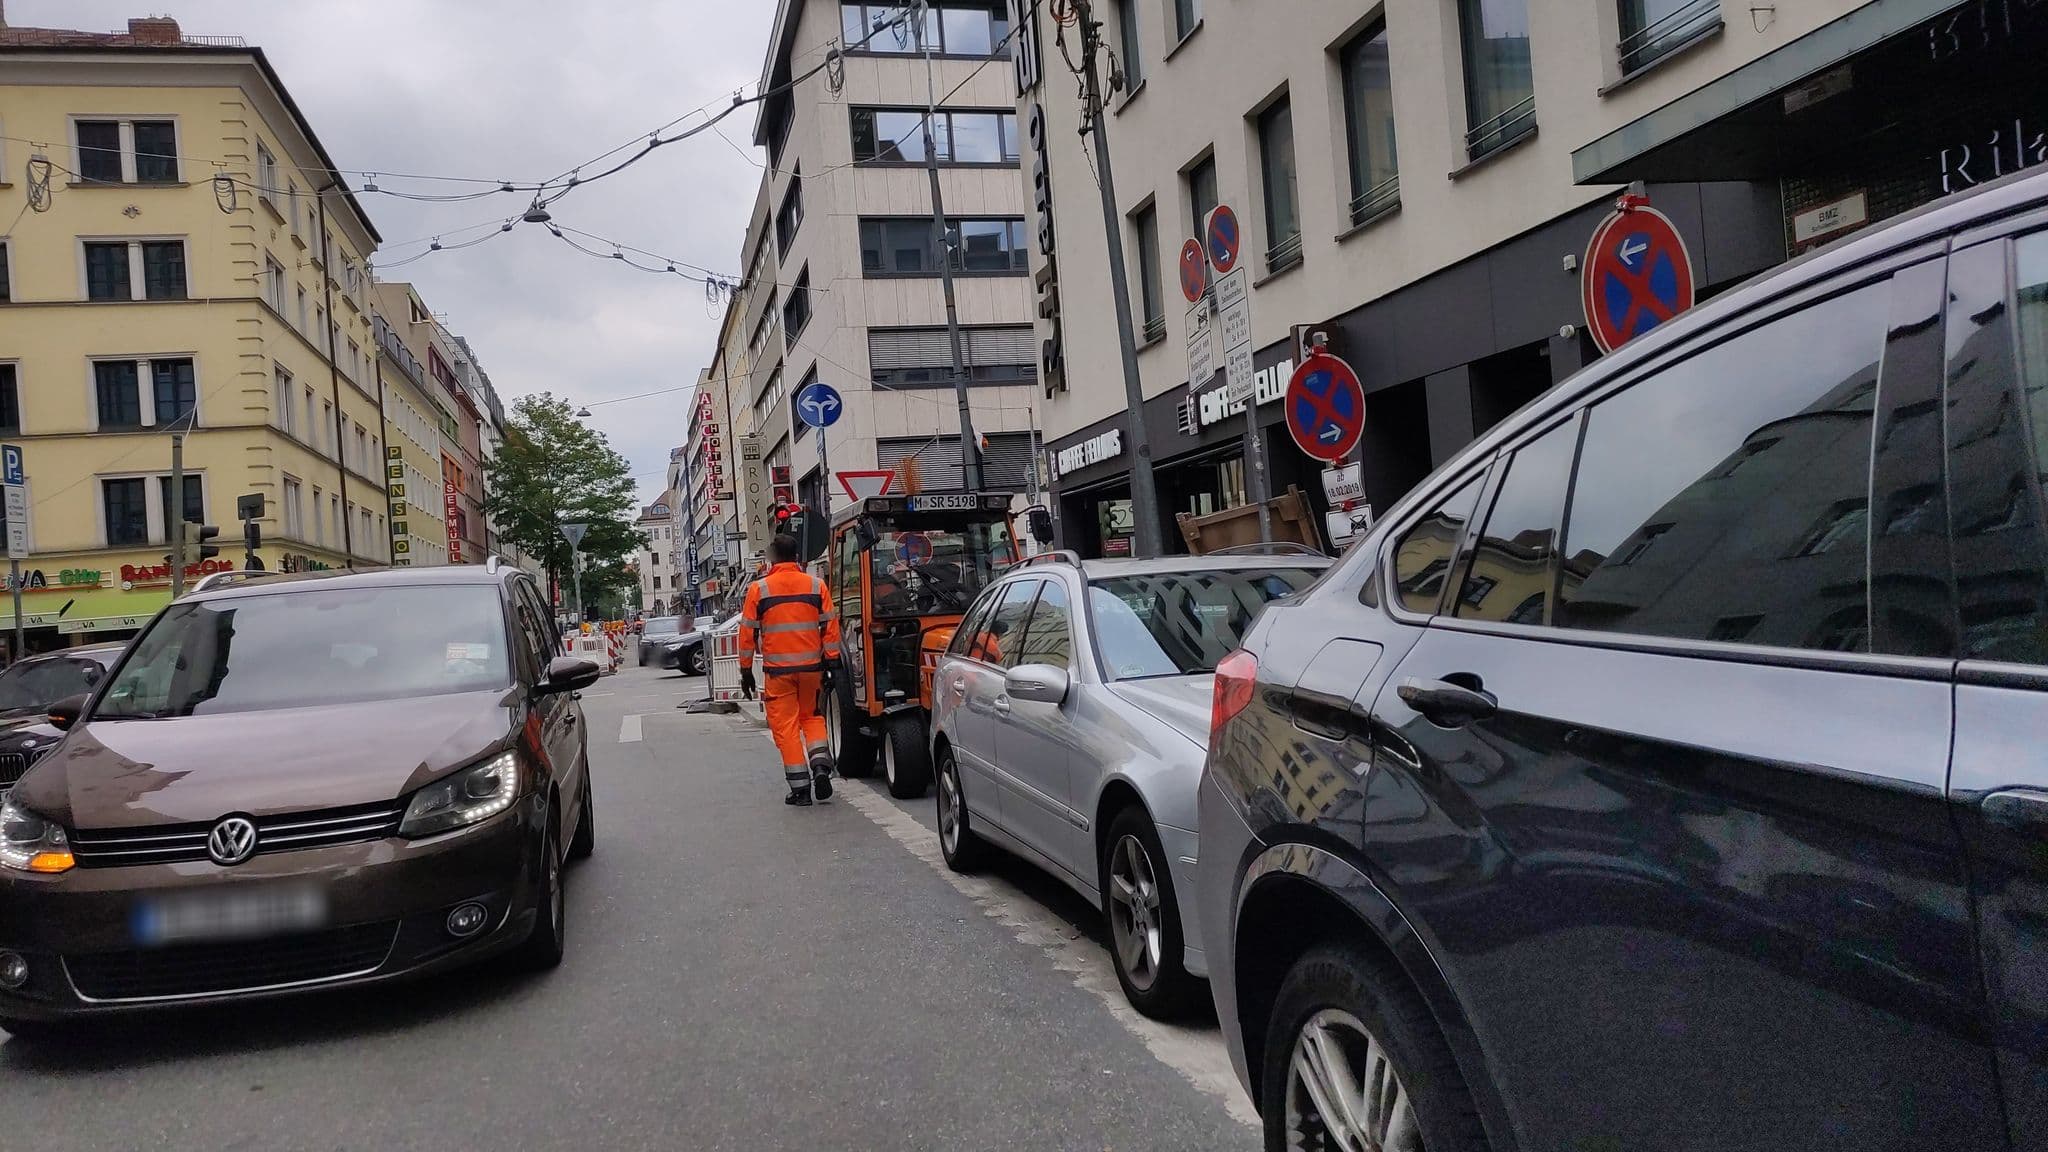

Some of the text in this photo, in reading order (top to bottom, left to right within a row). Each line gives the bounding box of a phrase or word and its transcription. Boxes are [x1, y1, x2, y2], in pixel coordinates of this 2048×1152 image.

[1818, 207, 1838, 222] BMZ
[710, 424, 723, 488] HOTEL
[1337, 473, 1345, 483] ab
[749, 467, 762, 541] ROYAL
[914, 495, 976, 509] M SR 5198
[120, 559, 234, 581] BANKOK
[691, 574, 700, 585] 5
